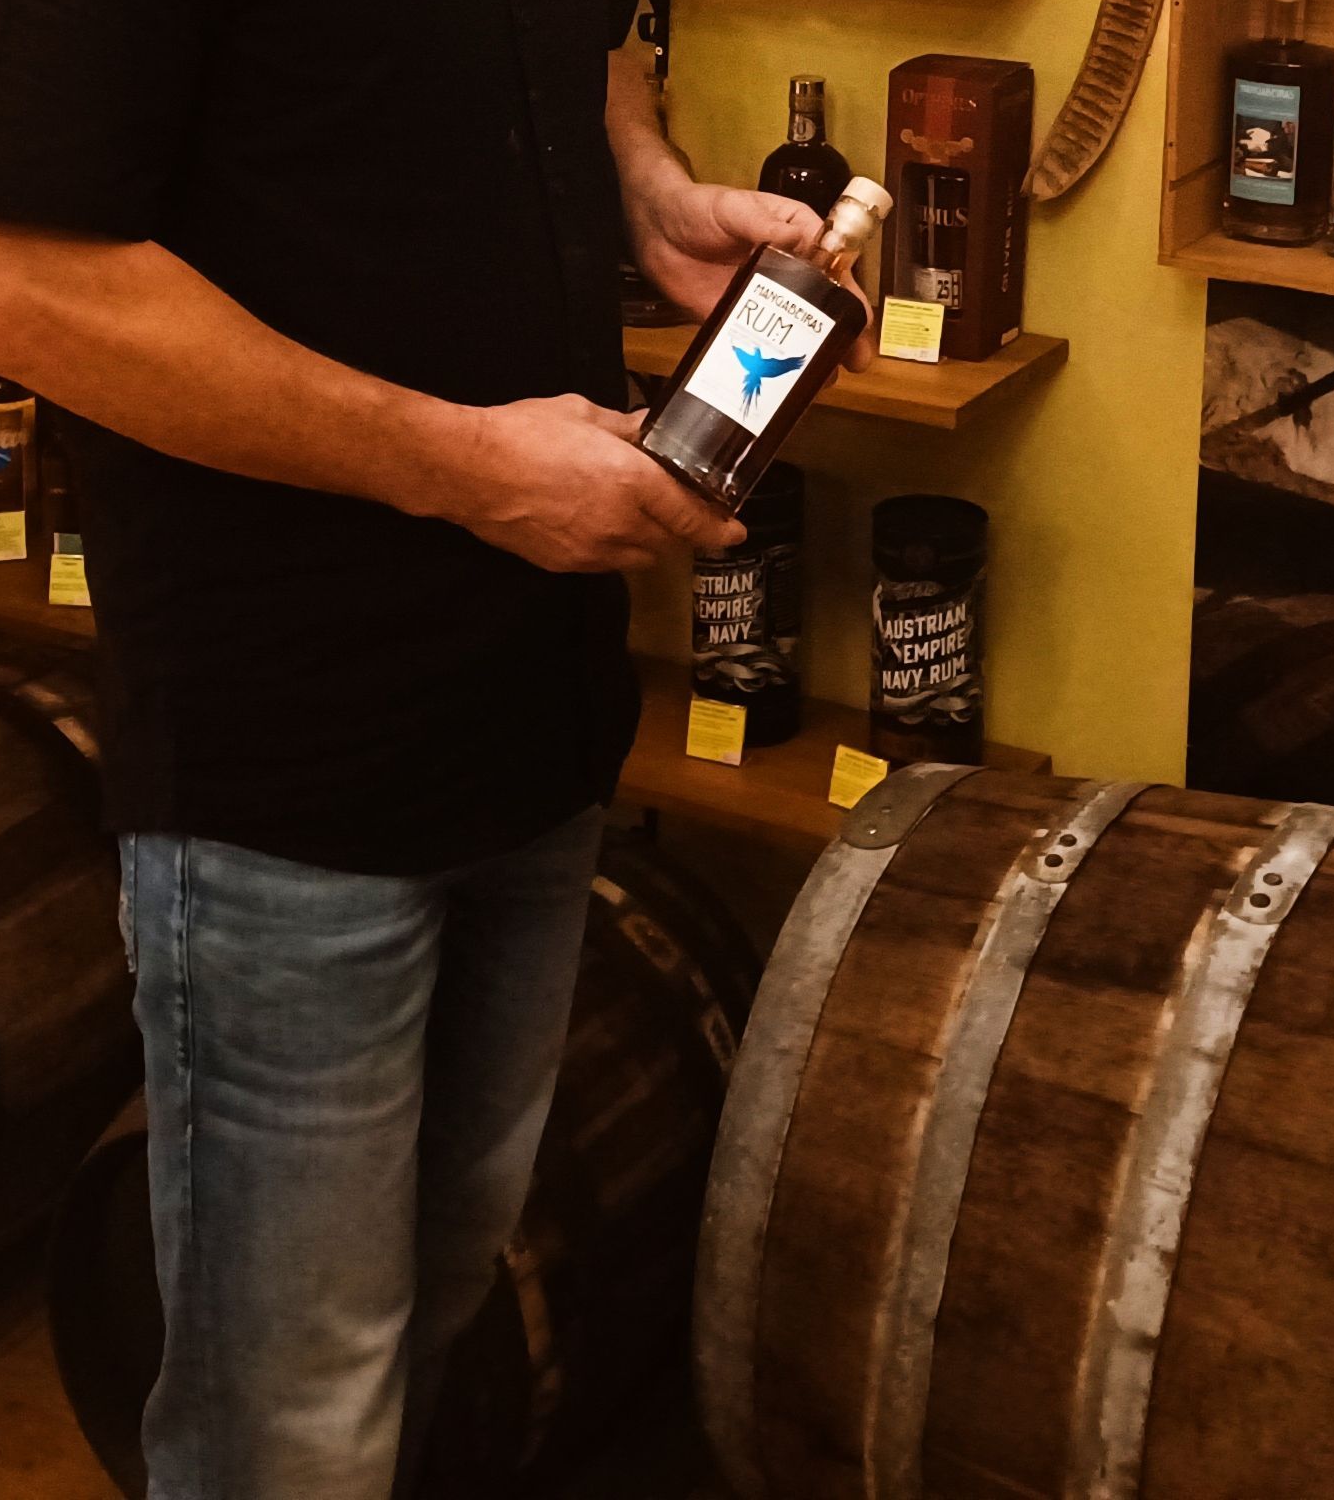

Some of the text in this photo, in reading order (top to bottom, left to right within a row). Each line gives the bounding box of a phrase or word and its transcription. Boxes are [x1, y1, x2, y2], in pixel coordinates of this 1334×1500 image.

[736, 299, 794, 345] RUM
[753, 283, 824, 334] MANGABEIRAS
[699, 597, 753, 619] EMPIRE
[883, 603, 967, 640] AUSTRIAN
[709, 622, 752, 644] NAVY
[903, 629, 966, 665] EMPIRE
[882, 654, 966, 691] NAVY RUM
